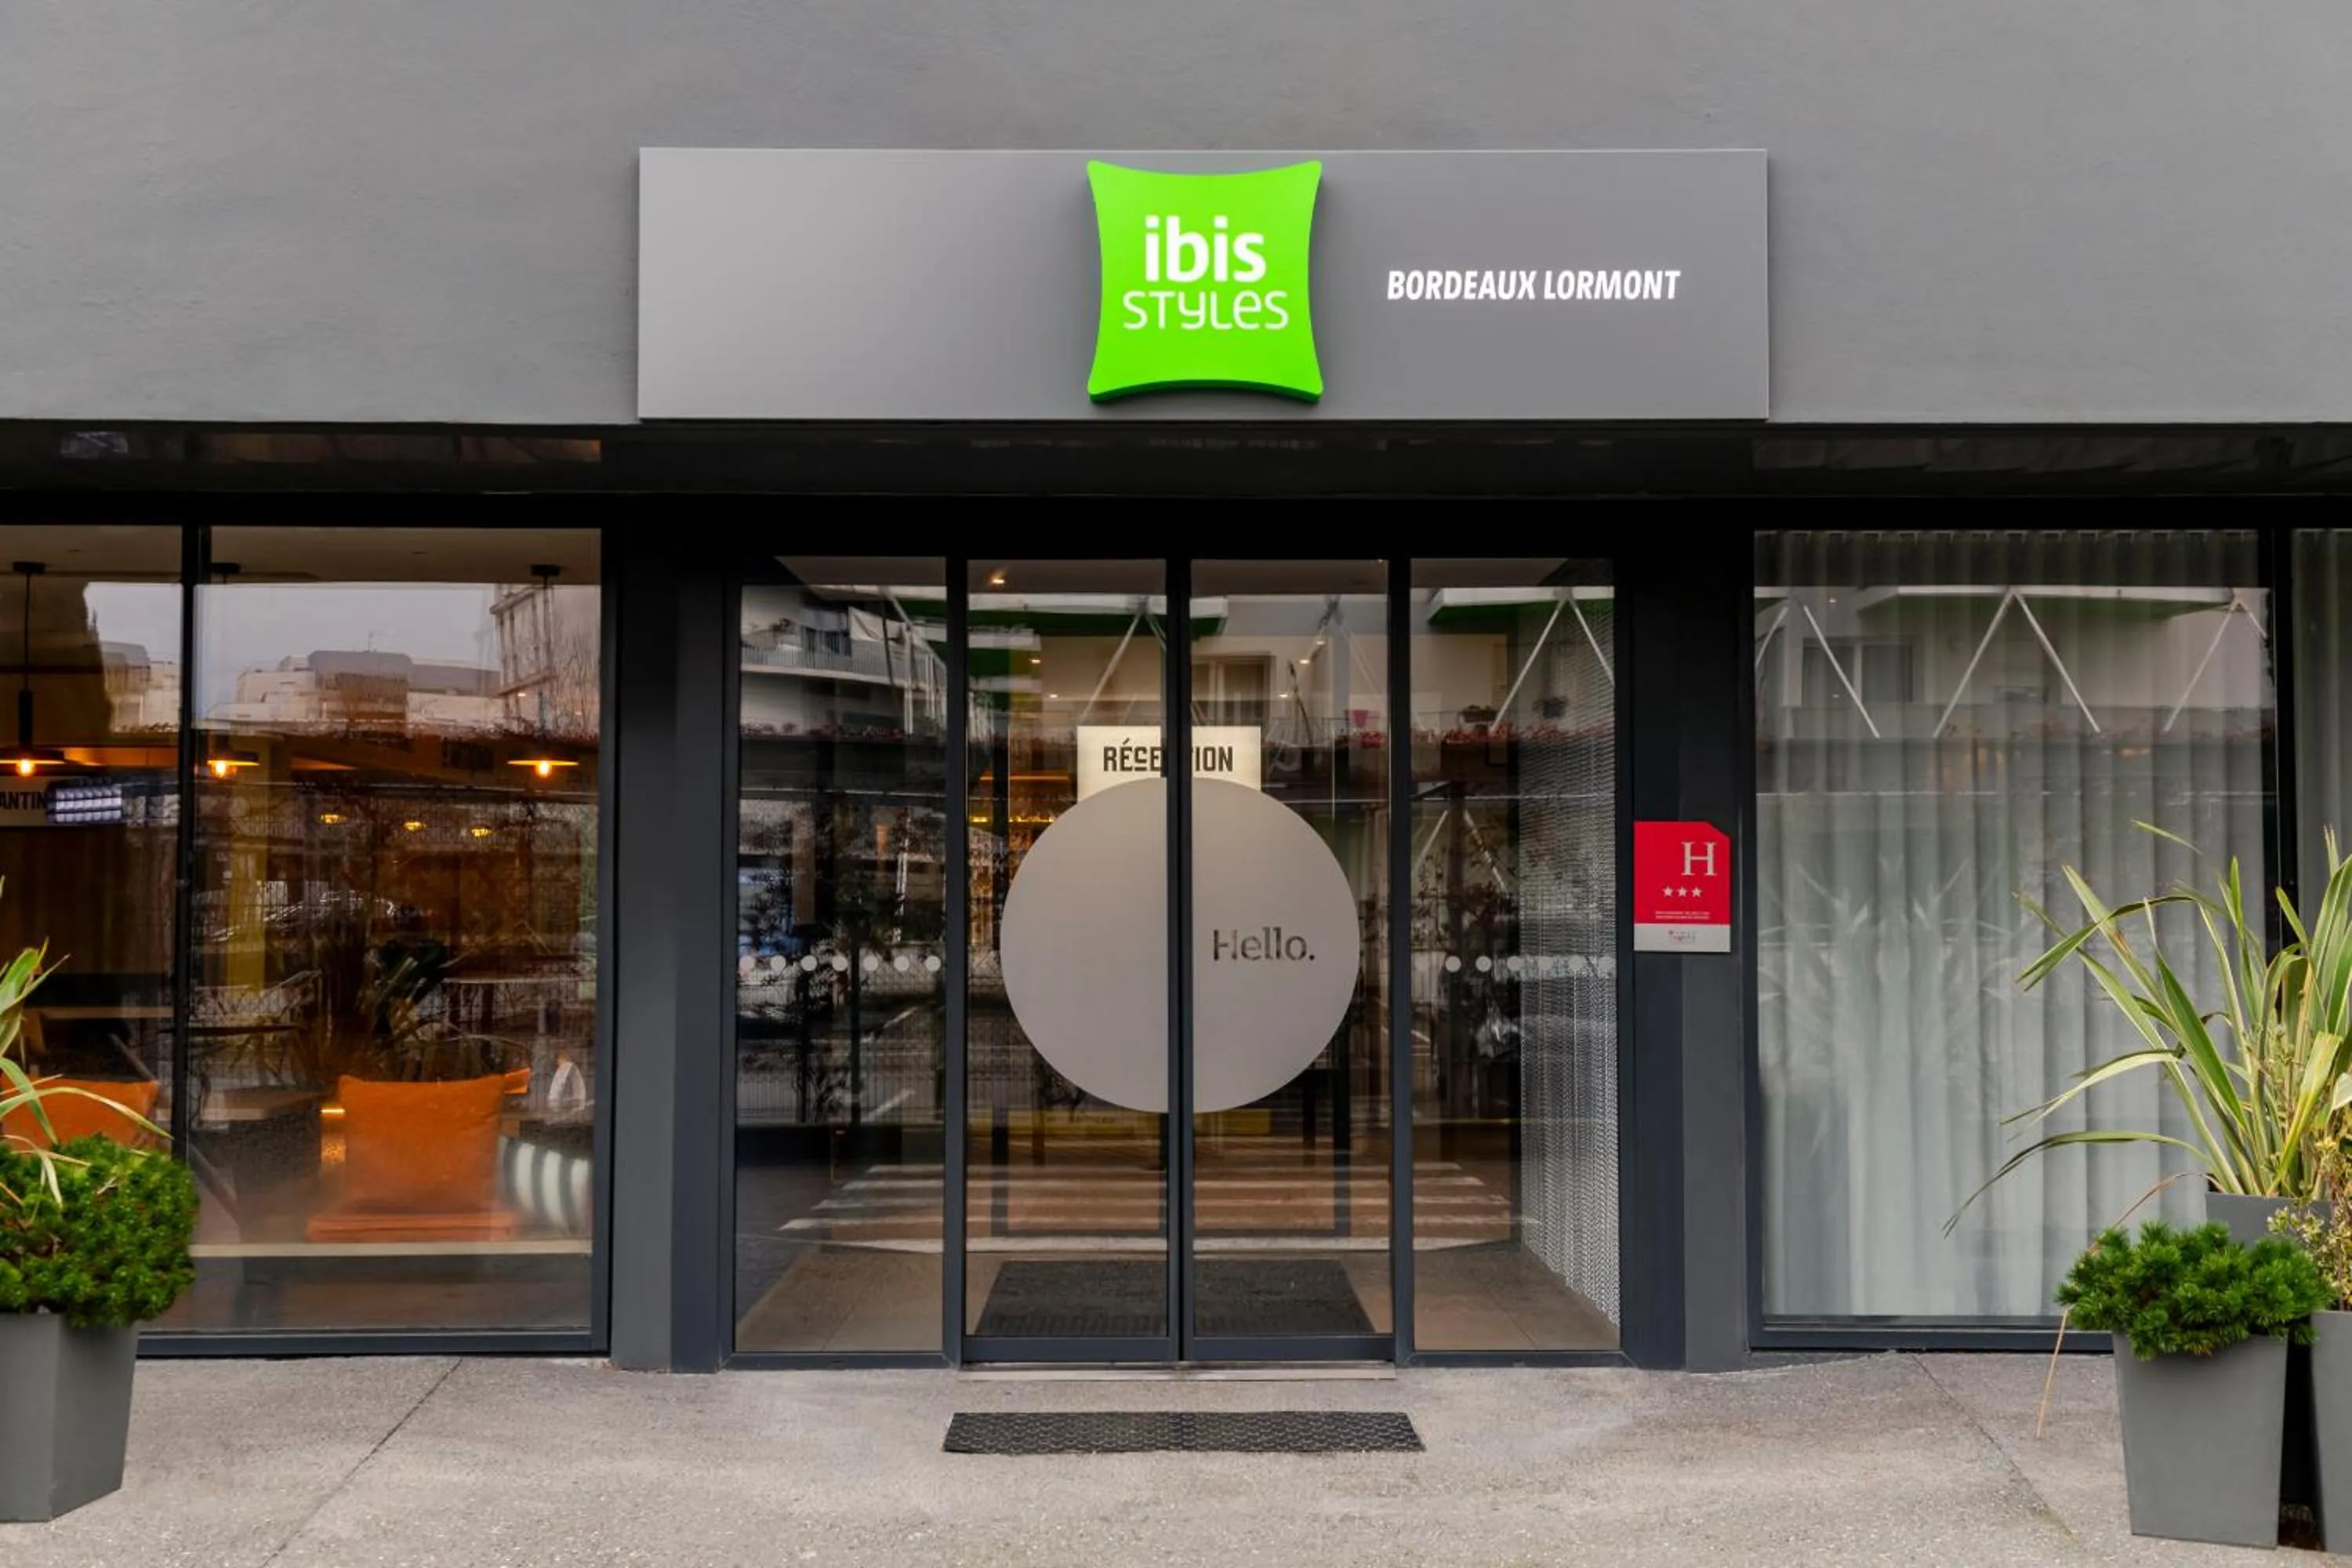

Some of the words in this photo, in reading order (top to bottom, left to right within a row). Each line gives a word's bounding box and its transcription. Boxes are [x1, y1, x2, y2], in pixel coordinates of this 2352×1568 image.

[1145, 215, 1266, 283] ibis
[1387, 270, 1537, 300] BORDEAUX
[1543, 270, 1682, 300] LORMONT
[1103, 738, 1233, 772] RÉCEION
[1681, 841, 1717, 876] H
[1213, 926, 1316, 962] Hello.
